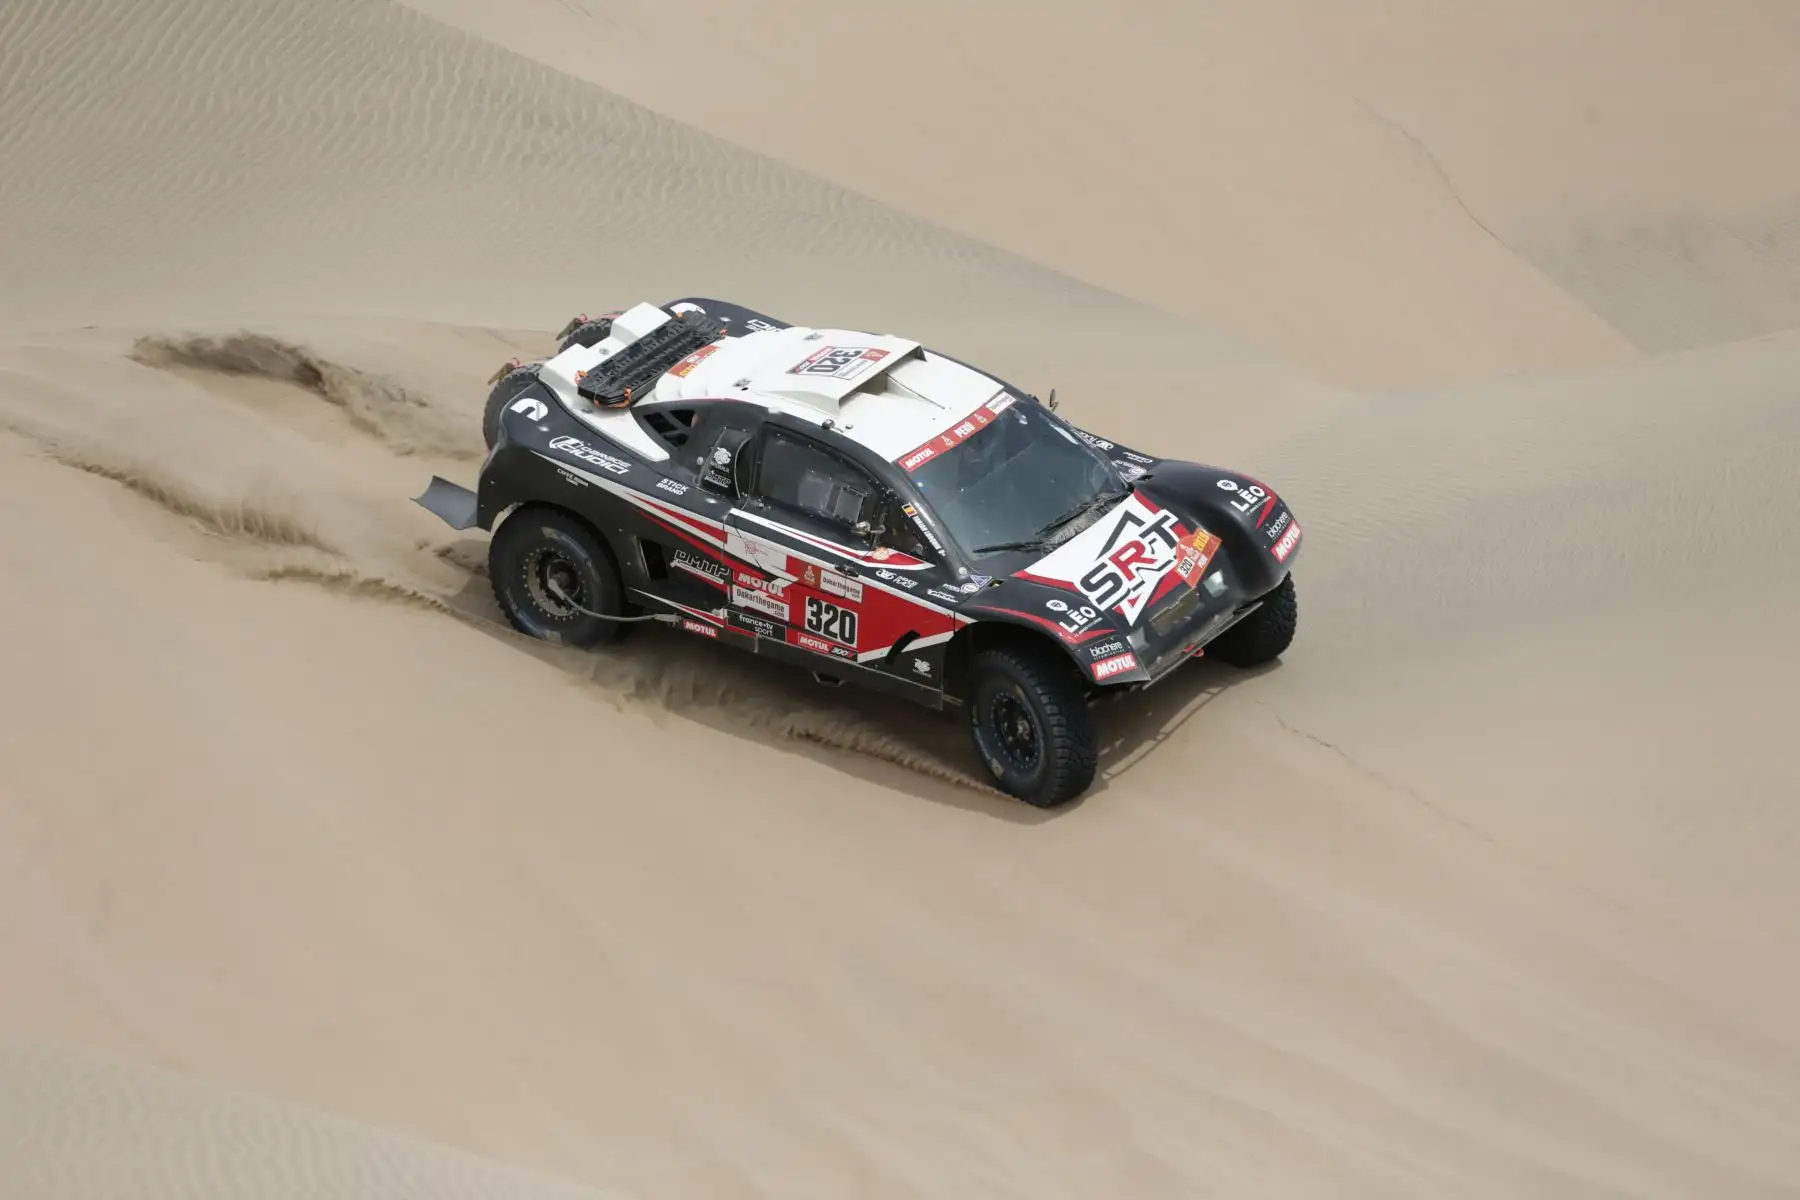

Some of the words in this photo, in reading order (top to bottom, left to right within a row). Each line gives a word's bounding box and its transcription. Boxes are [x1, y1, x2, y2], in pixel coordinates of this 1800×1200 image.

[806, 350, 863, 373] 320
[904, 447, 935, 469] MOTUL
[656, 482, 684, 496] BRAND
[660, 478, 689, 492] STICK
[1275, 523, 1301, 560] MOTUL
[1079, 514, 1179, 606] SRT
[1180, 558, 1193, 575] 320
[738, 572, 785, 597] MOTUL
[736, 588, 785, 613] Dakarthegame
[684, 621, 717, 637] MOTUL
[754, 626, 774, 638] sport
[806, 597, 857, 646] 320
[799, 636, 830, 652] MOTUL
[1096, 655, 1136, 678] MOTUL
